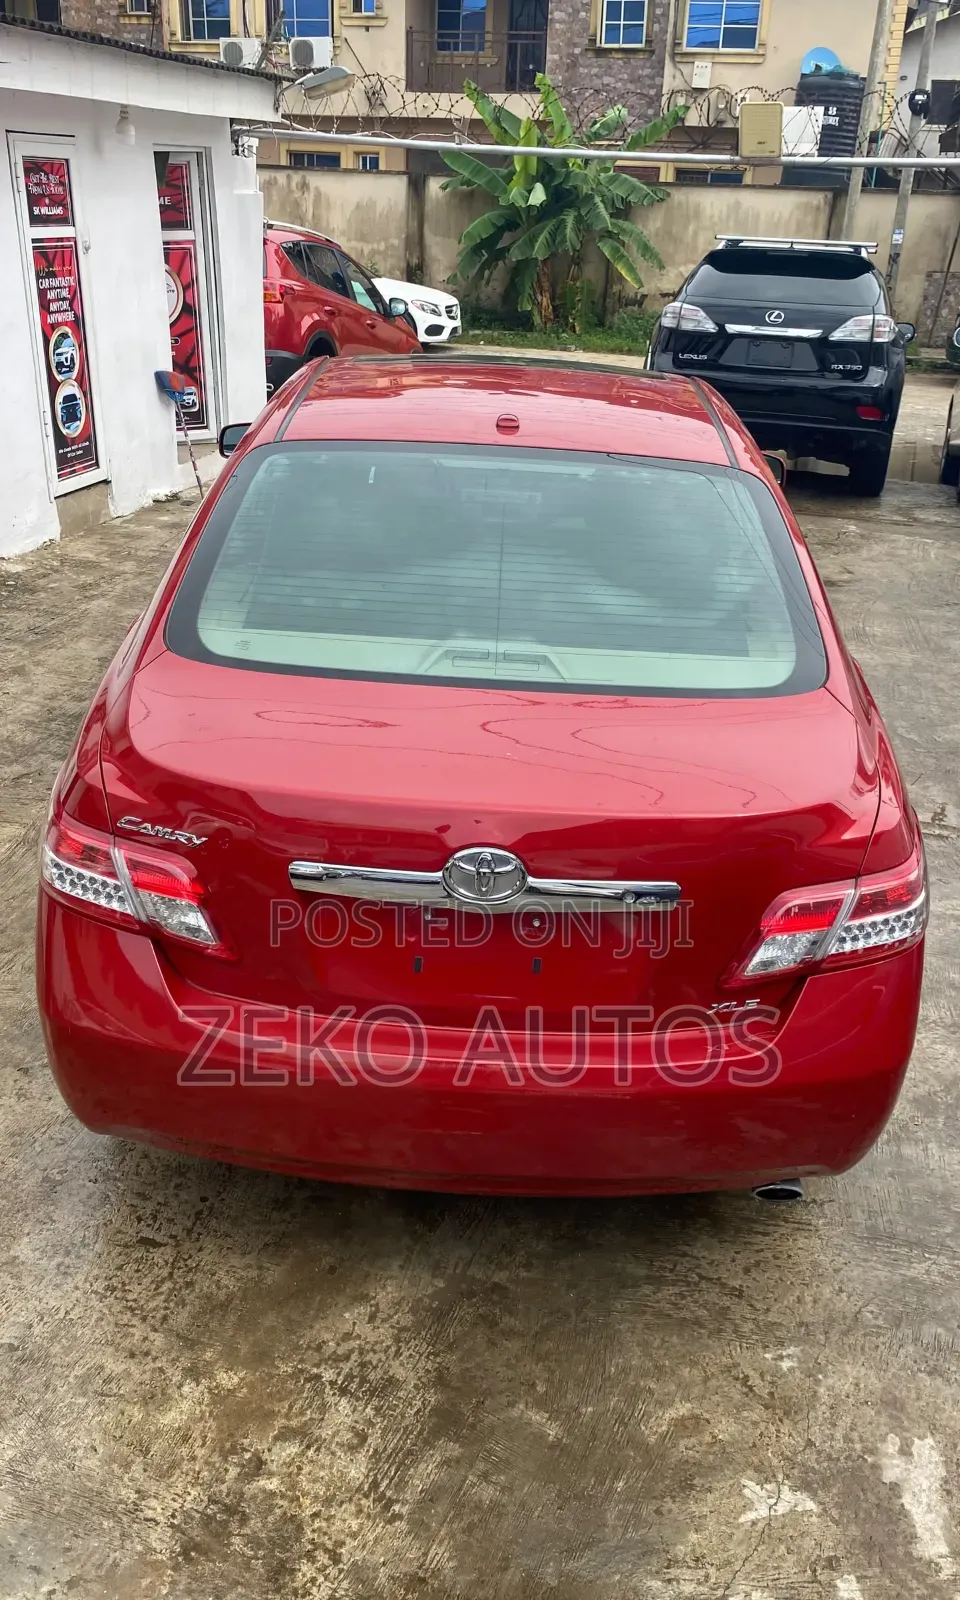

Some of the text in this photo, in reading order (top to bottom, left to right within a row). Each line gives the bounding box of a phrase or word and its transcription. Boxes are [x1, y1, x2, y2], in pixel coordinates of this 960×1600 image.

[39, 276, 75, 289] CAR FANTASTIC
[47, 310, 75, 324] ANYWHERE
[116, 815, 208, 848] CAMRY
[706, 999, 761, 1014] XLE
